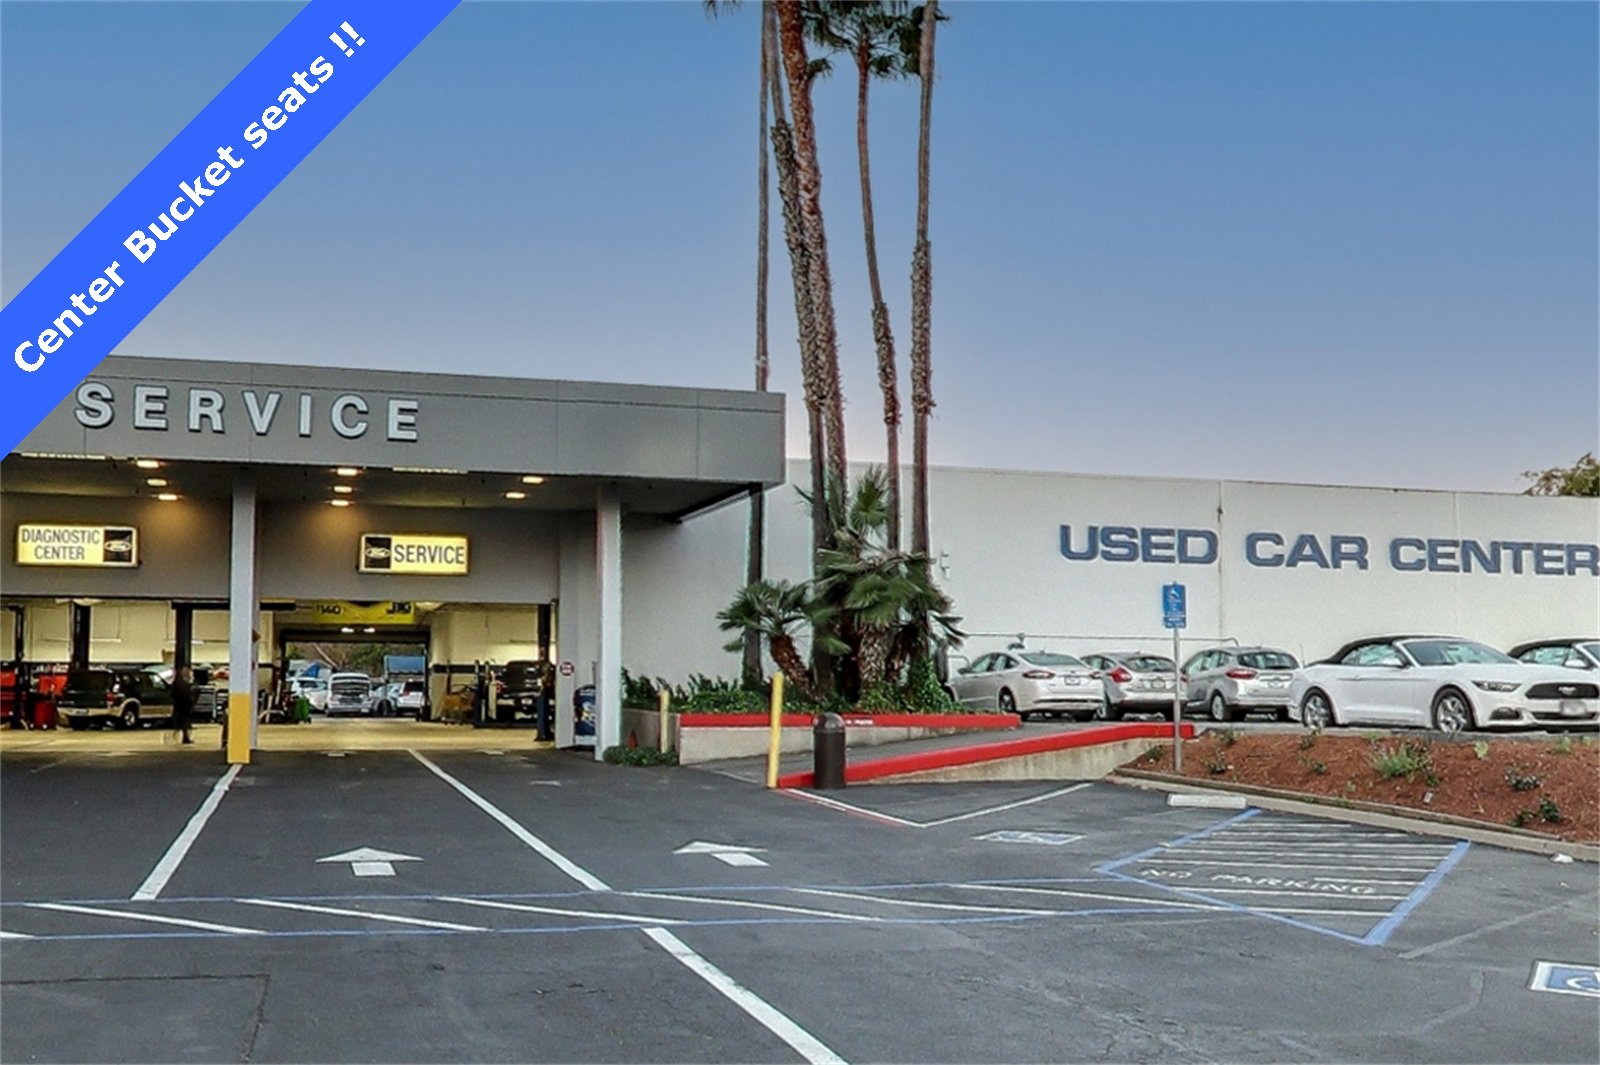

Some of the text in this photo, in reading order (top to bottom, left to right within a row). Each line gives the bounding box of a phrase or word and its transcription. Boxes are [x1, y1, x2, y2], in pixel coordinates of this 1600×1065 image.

[76, 382, 420, 442] SERVICE
[20, 527, 100, 545] DIAGNOSTIC
[35, 545, 86, 560] CENTER
[394, 544, 465, 564] SERVICE
[1060, 525, 1600, 576] USED CAR CENTER
[1140, 867, 1377, 895] NO PARKING
